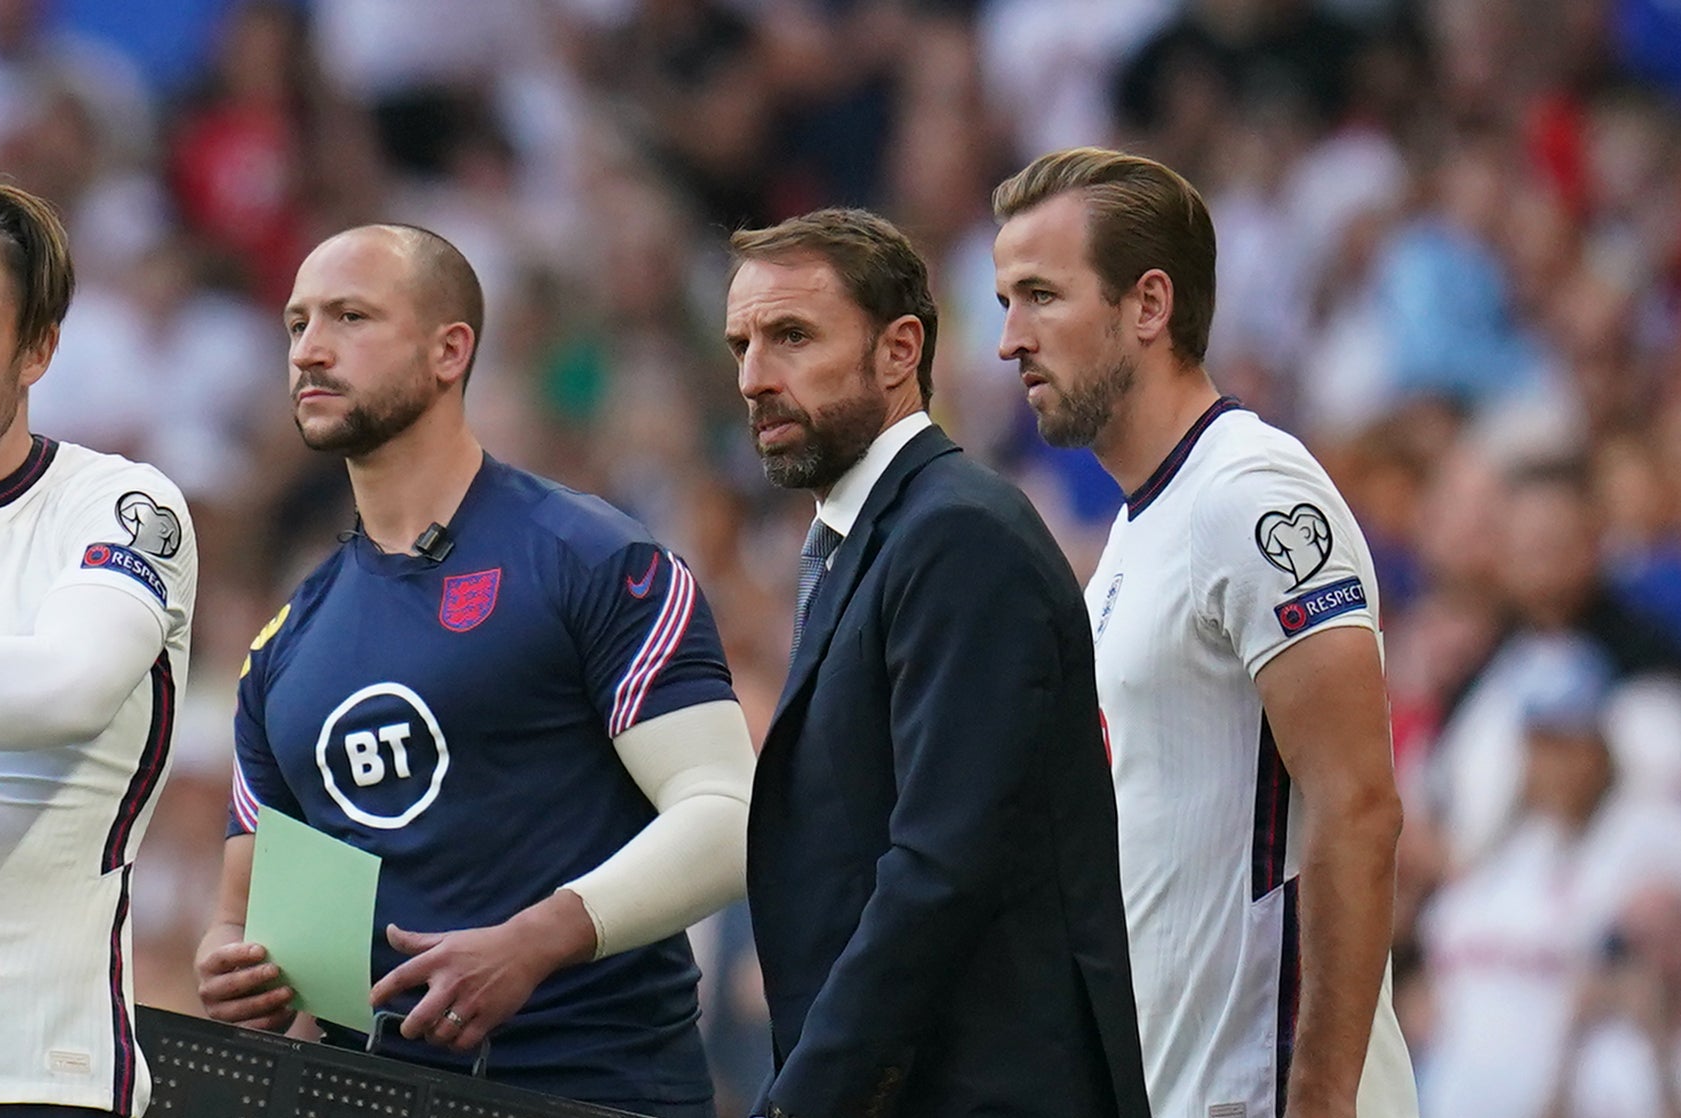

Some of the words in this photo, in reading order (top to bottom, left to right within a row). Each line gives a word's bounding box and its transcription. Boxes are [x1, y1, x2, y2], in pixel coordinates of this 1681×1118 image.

[111, 551, 166, 600] RESPECT
[1306, 584, 1364, 616] RESPECT
[344, 722, 412, 787] BT
